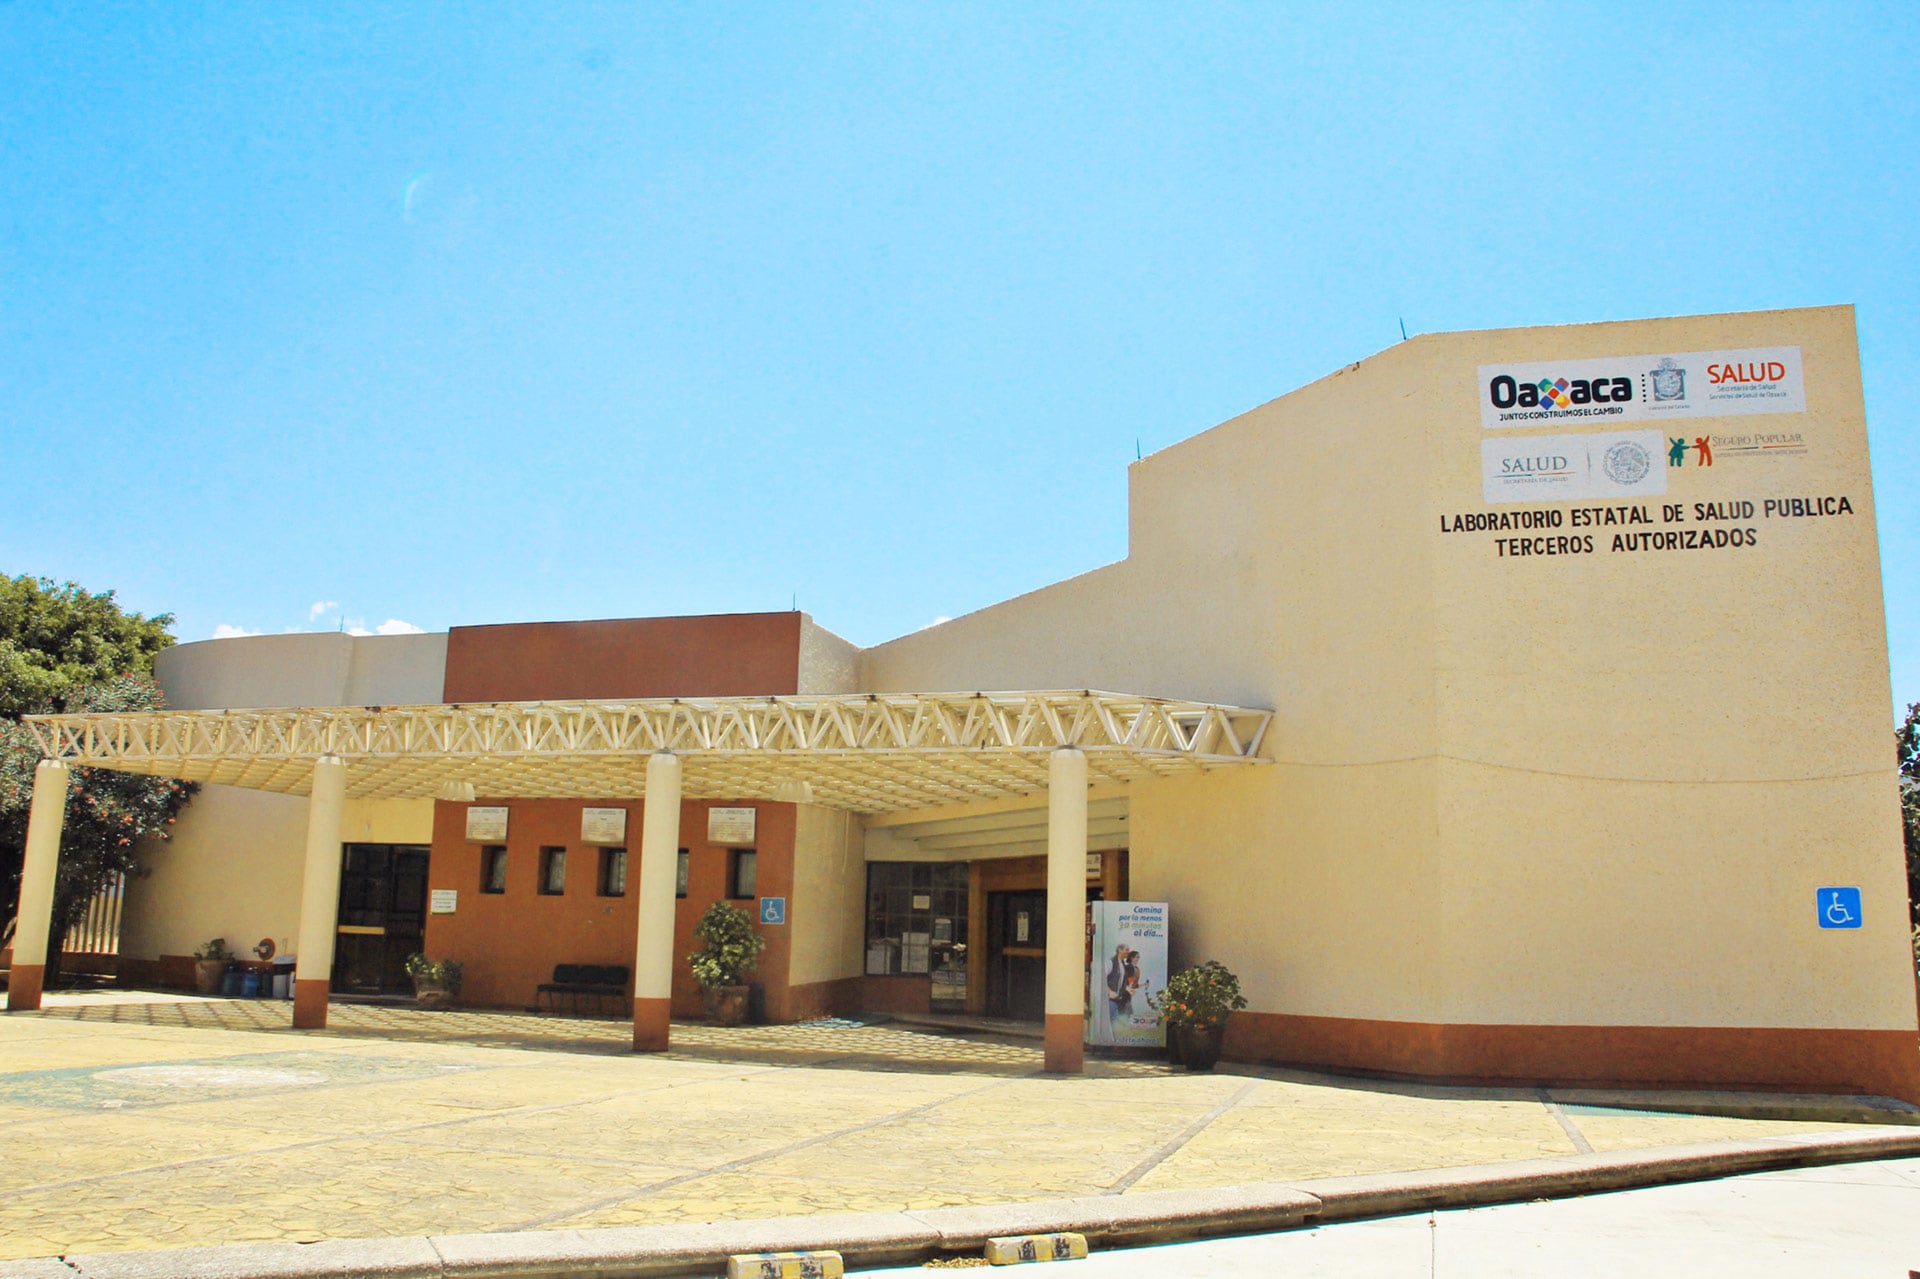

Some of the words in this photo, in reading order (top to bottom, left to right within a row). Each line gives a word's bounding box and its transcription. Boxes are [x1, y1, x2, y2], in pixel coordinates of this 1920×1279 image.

[1706, 361, 1786, 384] SALUD
[1489, 374, 1633, 409] Oaxaca
[1593, 406, 1623, 416] CAMBIO
[1502, 456, 1568, 473] SALUD
[1440, 509, 1563, 533] LABORATORIO
[1570, 505, 1654, 528] ESTATAL
[1663, 503, 1684, 523] DE
[1694, 500, 1755, 521] SALUD
[1764, 496, 1854, 518] PUBLICA
[1495, 534, 1594, 557] TERCEROS
[1611, 528, 1758, 553] AUTORIZADOS
[1119, 914, 1130, 922] por
[1133, 905, 1162, 914] Camina
[1131, 921, 1162, 929] minutos
